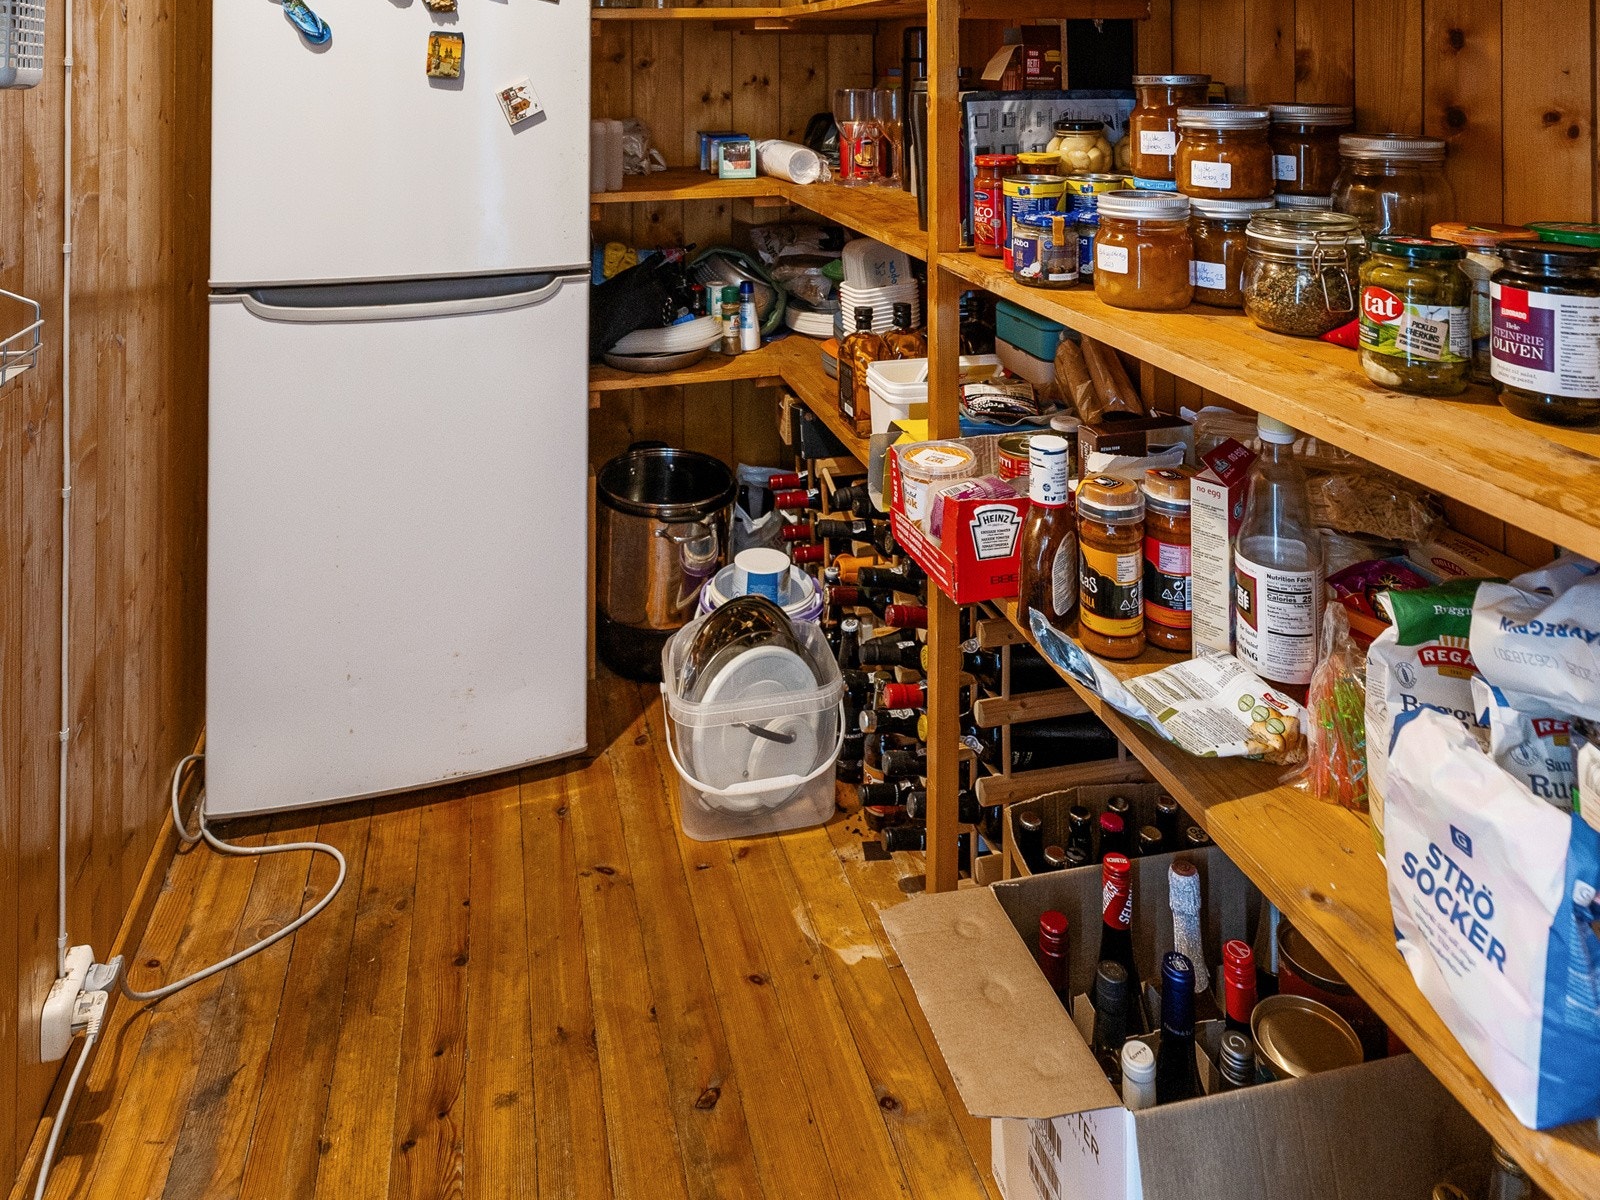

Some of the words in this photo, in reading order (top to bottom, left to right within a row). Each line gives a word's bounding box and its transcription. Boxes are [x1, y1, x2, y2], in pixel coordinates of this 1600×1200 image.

[1364, 291, 1398, 317] tat
[1411, 320, 1438, 333] PICKLED
[1506, 322, 1521, 331] Hele
[1494, 327, 1544, 347] STEINFRIE
[1493, 336, 1545, 360] OLIVEN
[1196, 485, 1206, 493] no
[1207, 489, 1222, 500] egg
[982, 514, 1010, 524] HEINZ
[1266, 573, 1295, 583] Nutrition
[1266, 593, 1297, 603] Calories
[1302, 595, 1312, 603] 25
[1245, 629, 1257, 638] Sushi
[1422, 650, 1475, 667] REGA
[1538, 719, 1565, 732] RE
[1426, 842, 1495, 921] STRÖ
[1401, 851, 1507, 974] SOCKER
